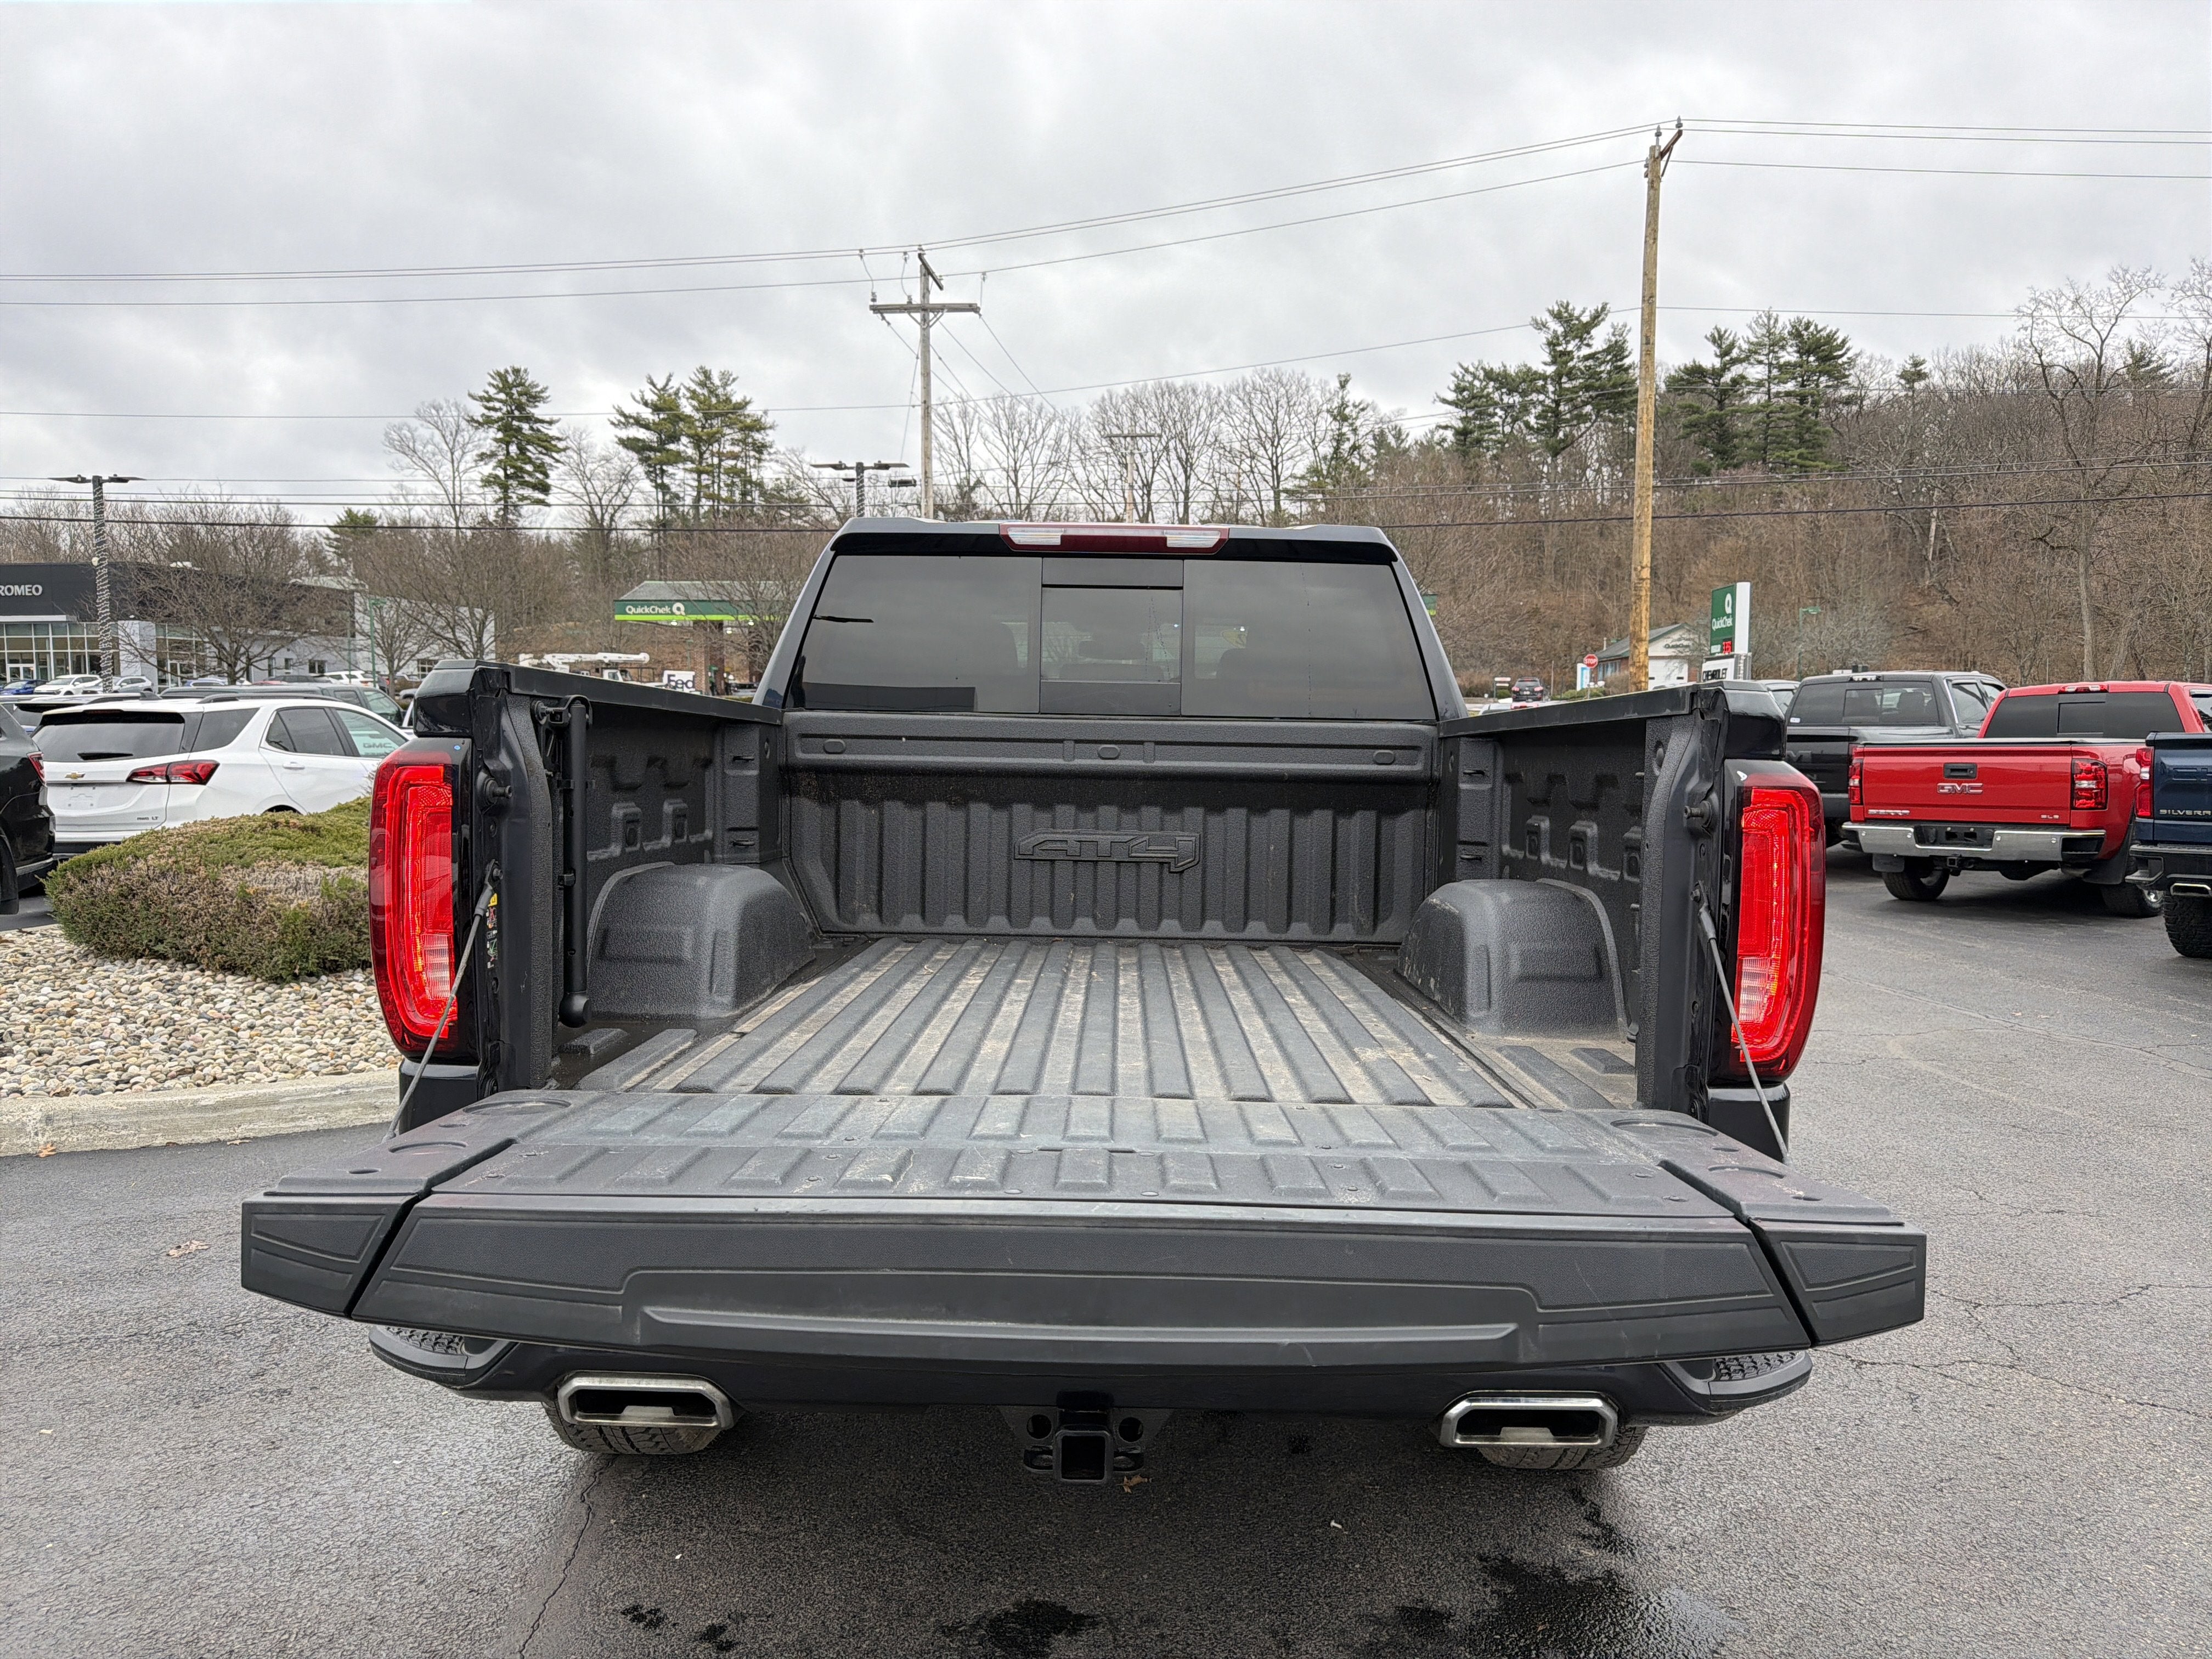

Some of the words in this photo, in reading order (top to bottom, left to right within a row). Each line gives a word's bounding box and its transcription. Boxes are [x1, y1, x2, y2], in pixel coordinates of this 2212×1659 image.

[0, 584, 43, 596] ROMEO
[625, 605, 671, 614] QuickChek
[1712, 614, 1733, 631] QuickChek
[1937, 783, 1983, 794] GMC
[1017, 831, 1198, 871] AT4
